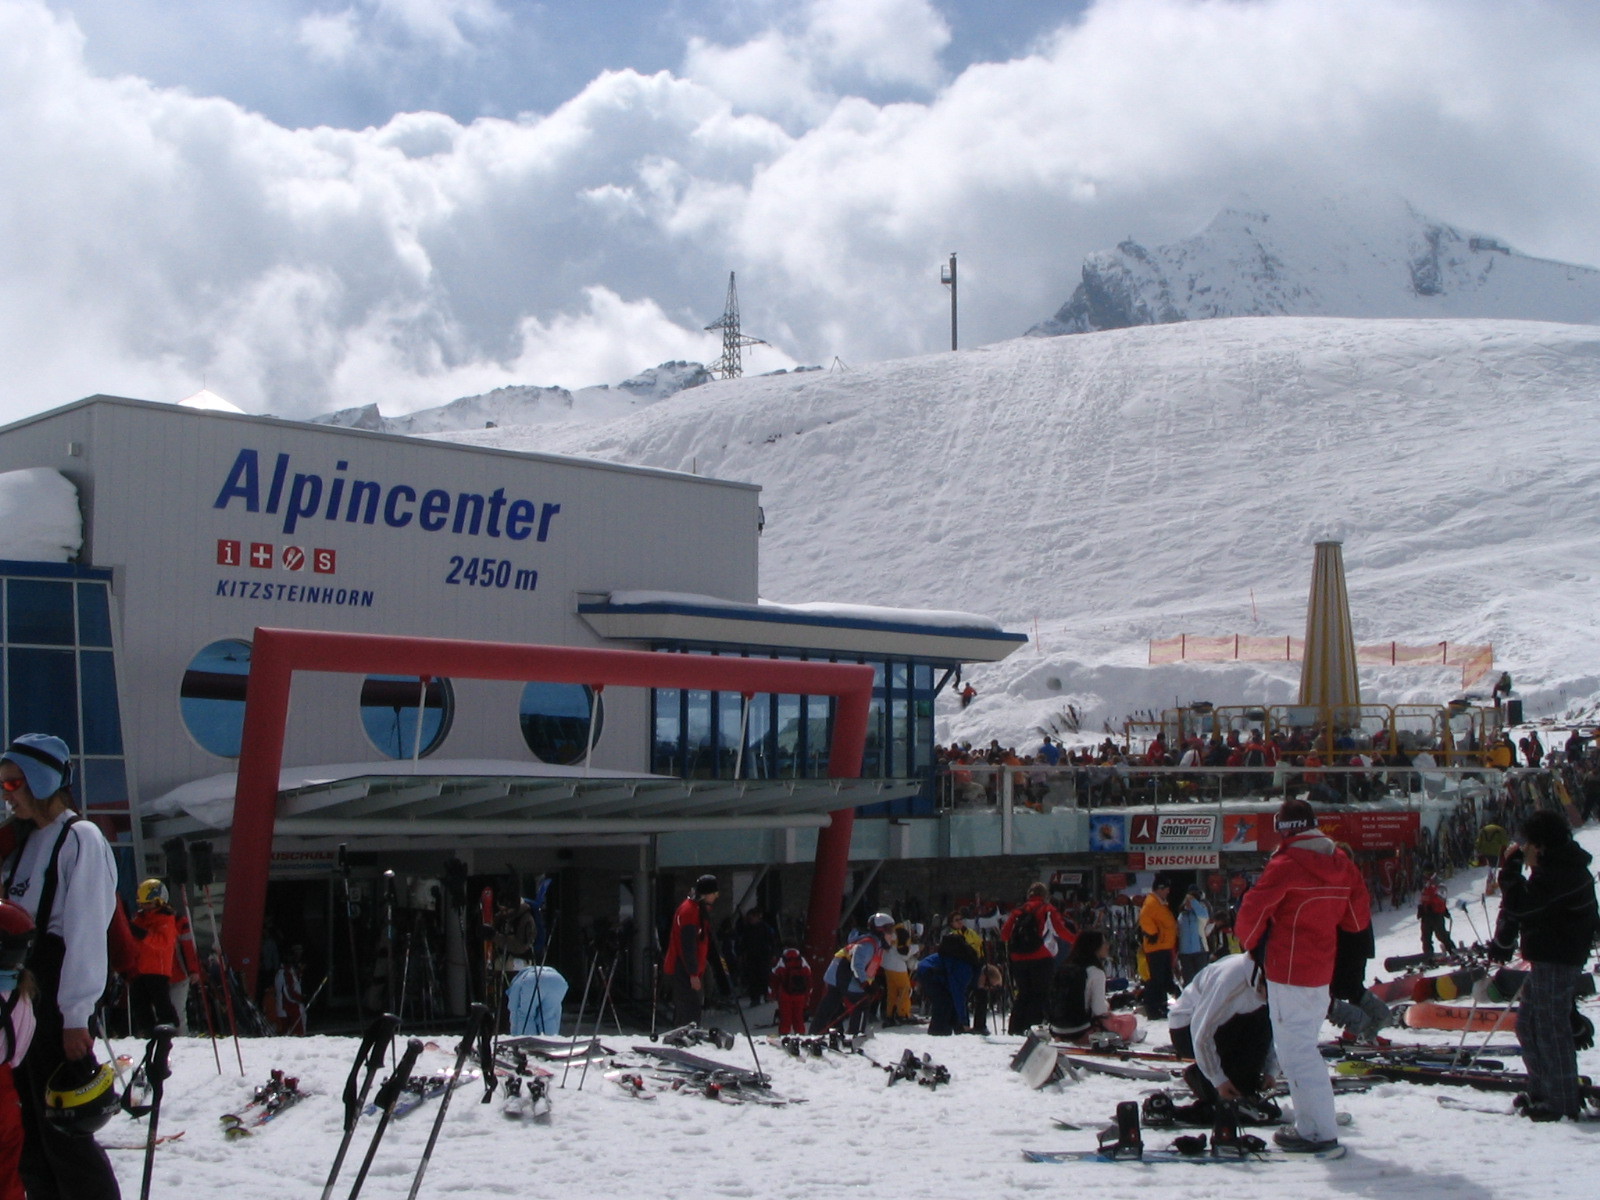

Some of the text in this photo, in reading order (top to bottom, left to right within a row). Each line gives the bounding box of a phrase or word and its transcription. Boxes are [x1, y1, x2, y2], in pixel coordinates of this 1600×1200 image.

[213, 449, 561, 542] Alpincenter
[446, 556, 539, 592] 2450 m
[216, 579, 374, 608] KITZSTEINHORN
[1162, 817, 1212, 825] ATOMIC
[1278, 818, 1307, 830] SMITH
[1147, 855, 1217, 865] SKISCHULE
